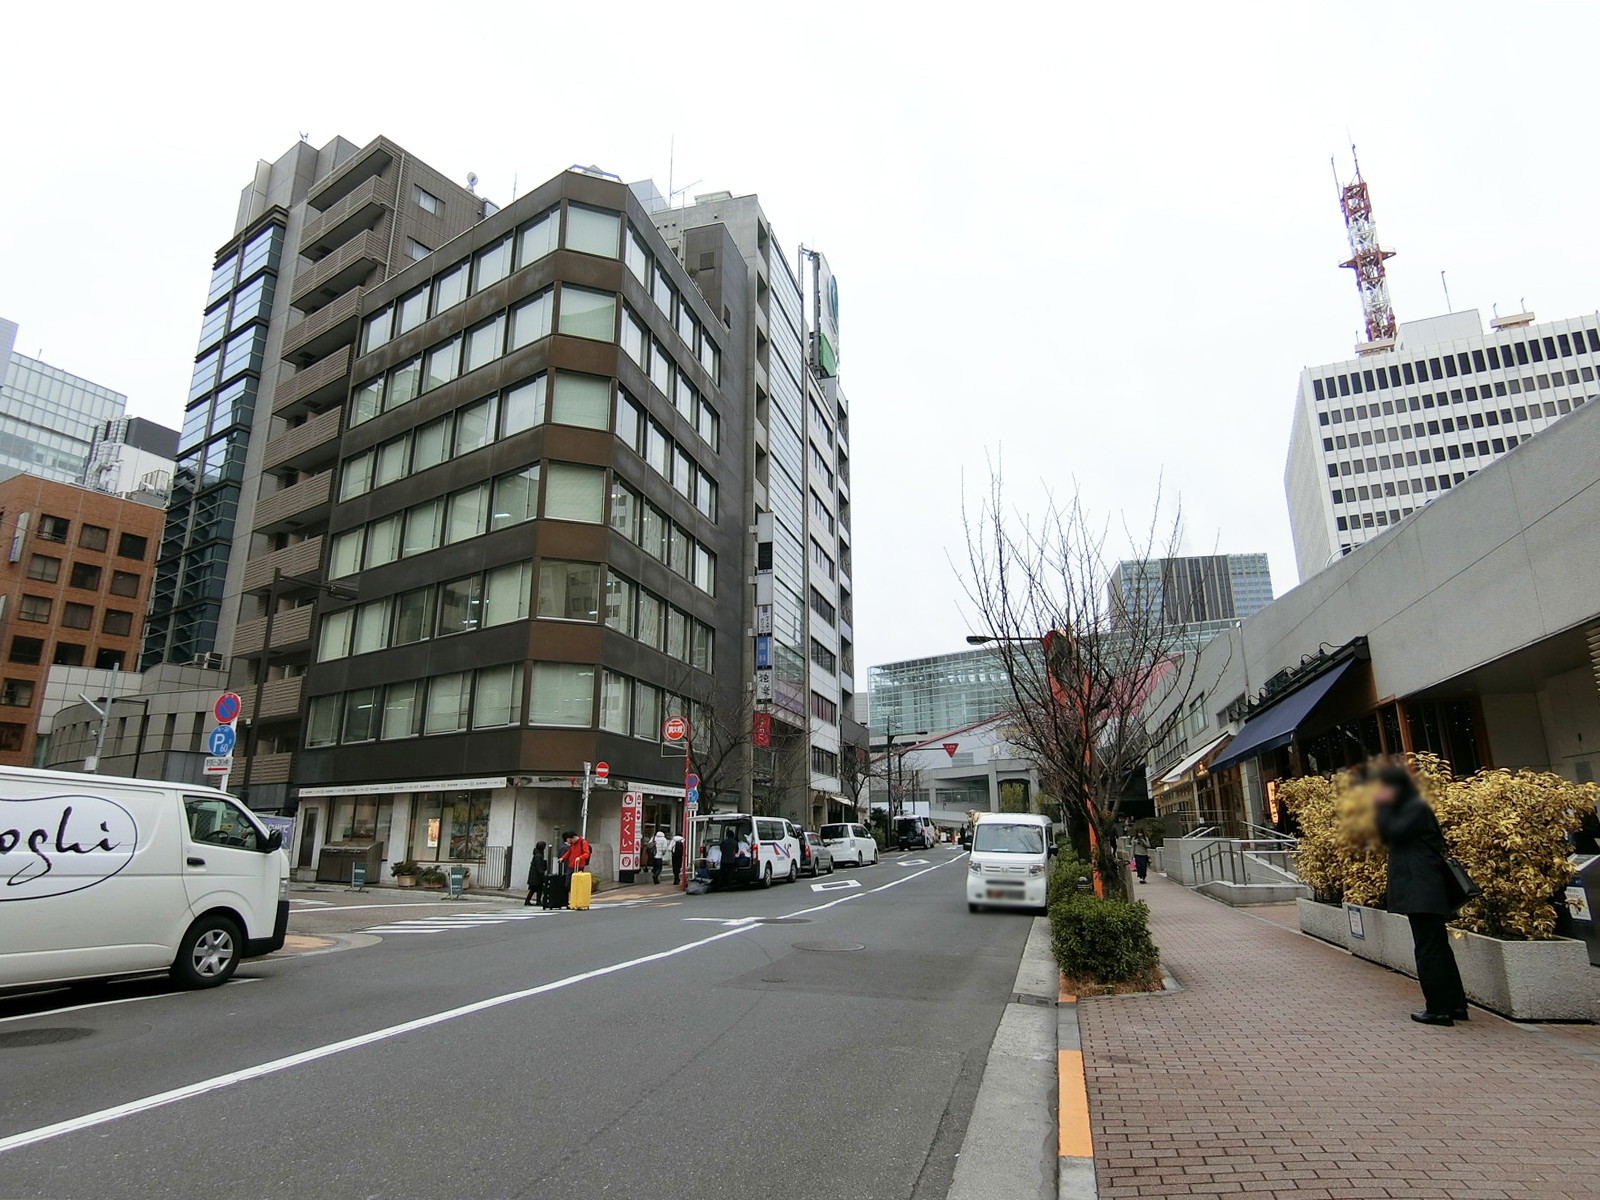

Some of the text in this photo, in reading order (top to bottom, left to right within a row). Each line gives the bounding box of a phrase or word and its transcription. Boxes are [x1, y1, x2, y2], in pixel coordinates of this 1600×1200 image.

[213, 733, 226, 752] P
[219, 743, 229, 753] 60
[622, 811, 634, 848] ふくい
